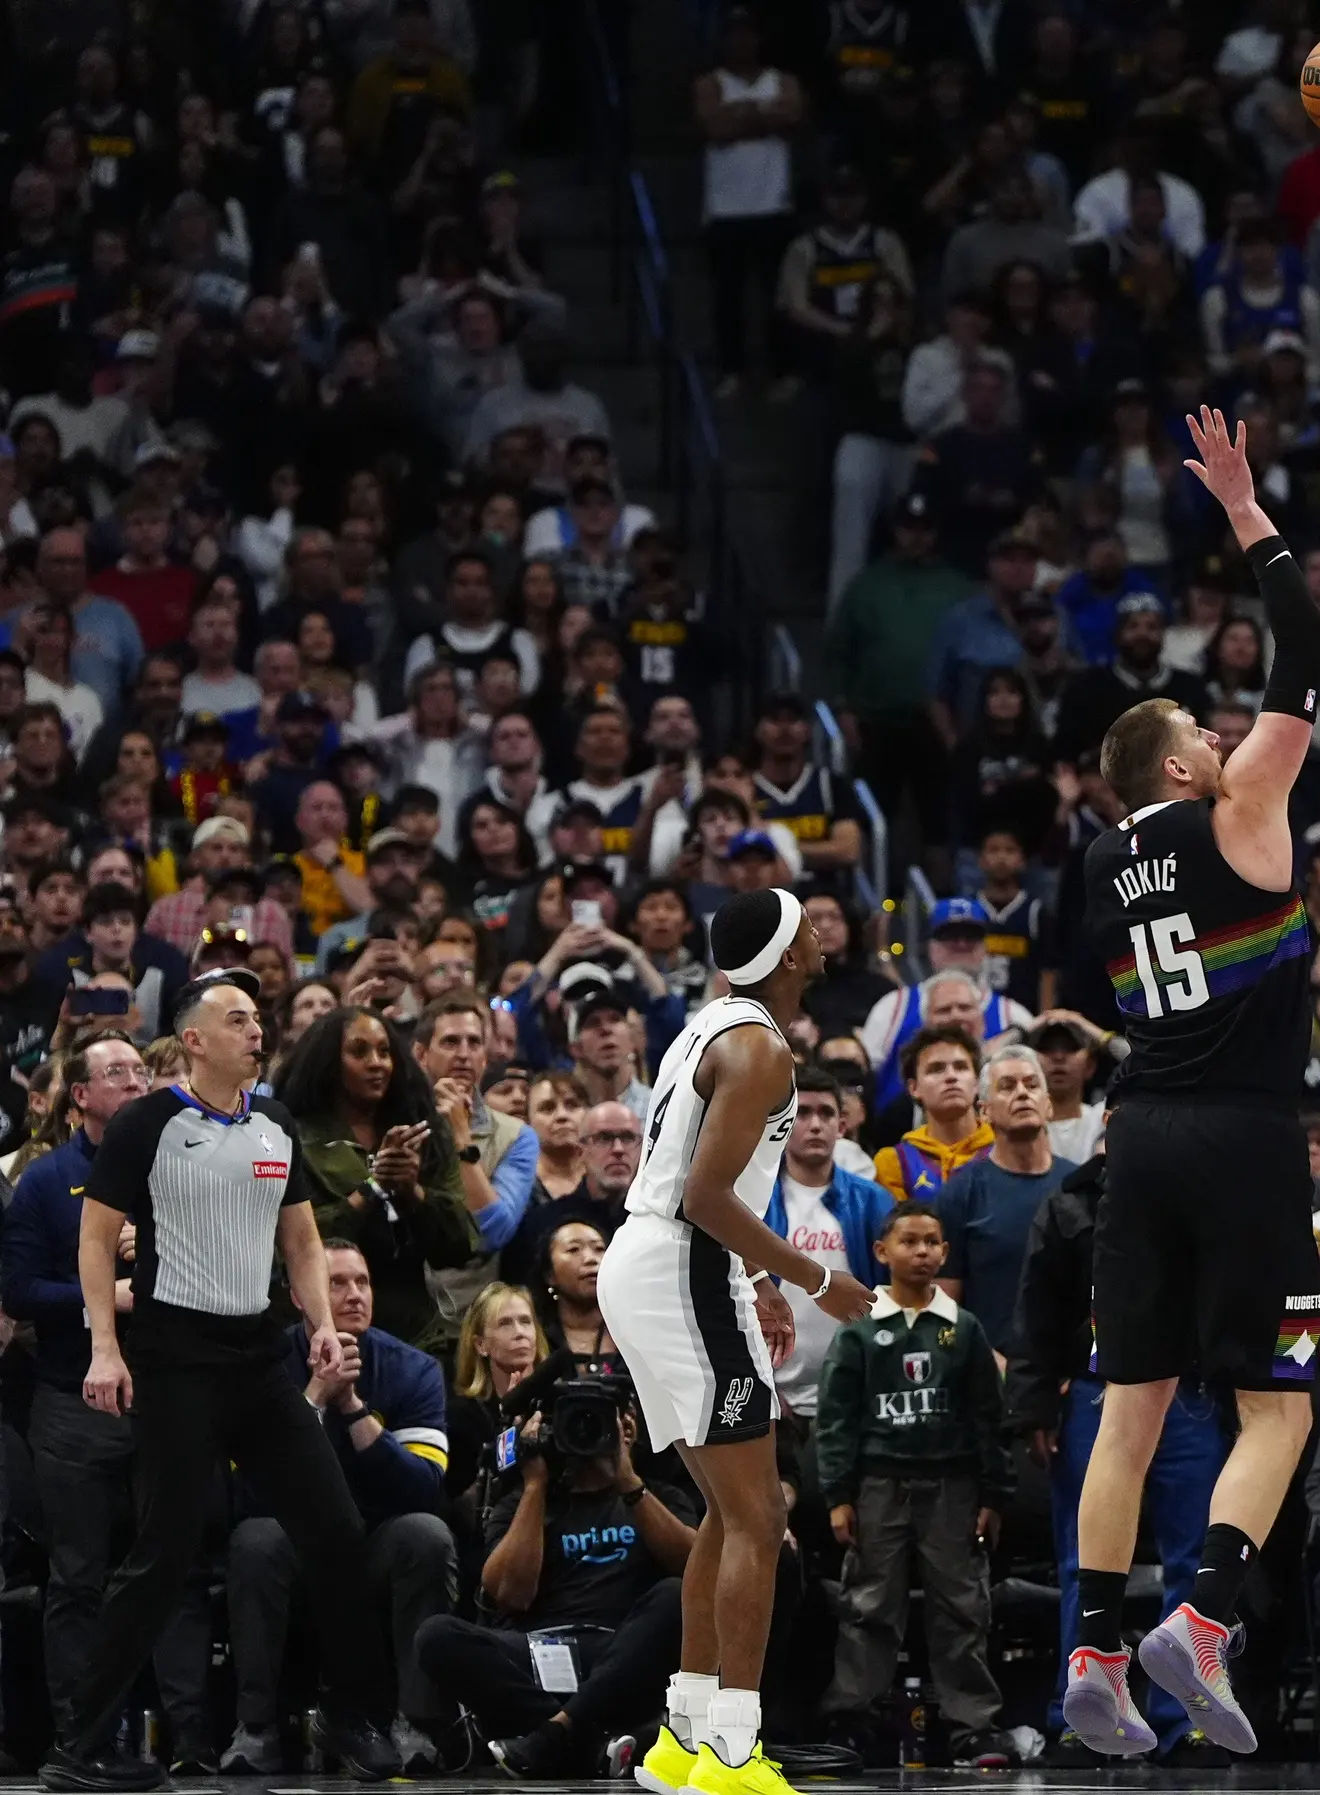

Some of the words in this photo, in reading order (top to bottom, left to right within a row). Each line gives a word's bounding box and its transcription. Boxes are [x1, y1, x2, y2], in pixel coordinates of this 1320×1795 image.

[1113, 852, 1177, 908] JOKIĆ
[1129, 912, 1210, 1019] 15
[643, 1082, 677, 1166] 4
